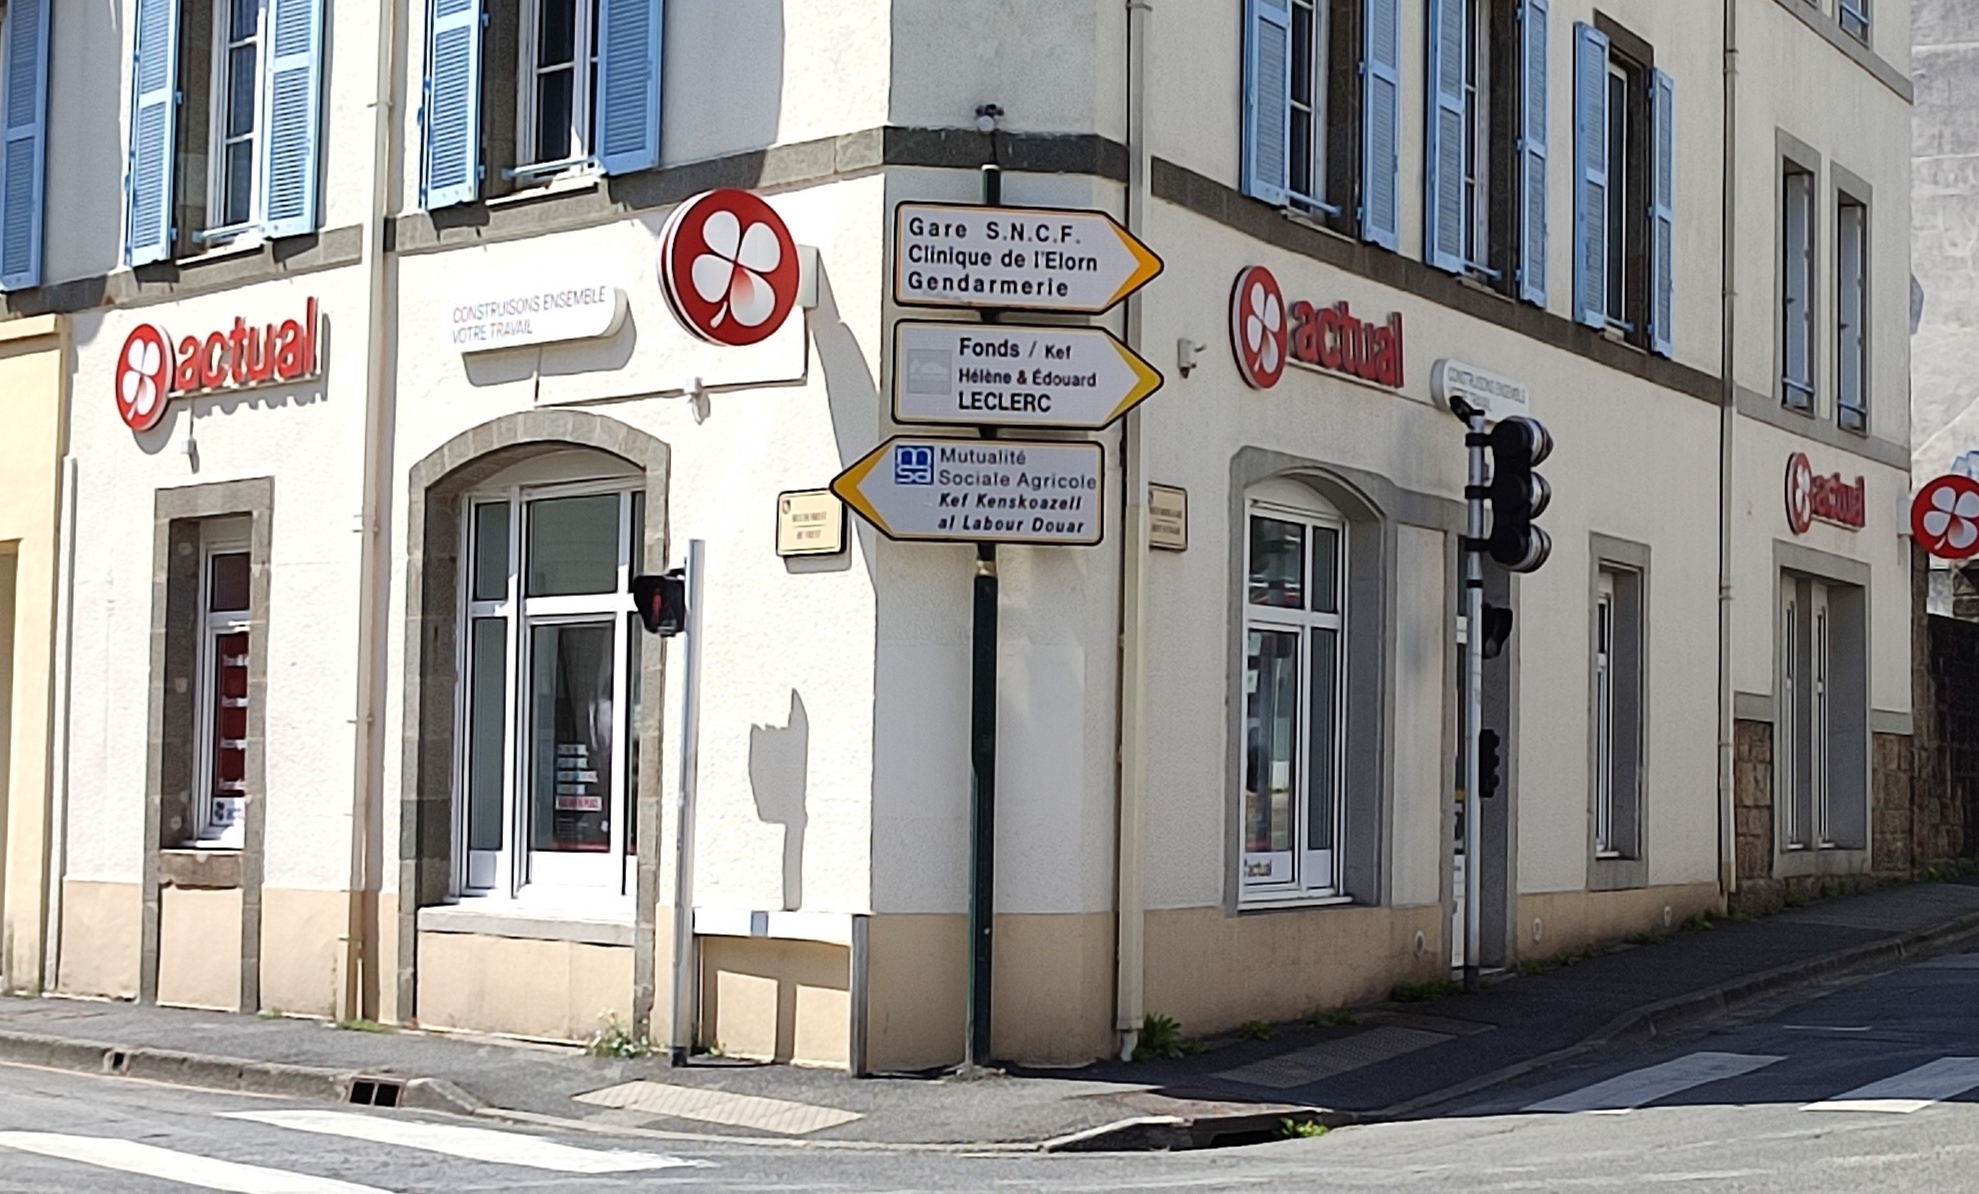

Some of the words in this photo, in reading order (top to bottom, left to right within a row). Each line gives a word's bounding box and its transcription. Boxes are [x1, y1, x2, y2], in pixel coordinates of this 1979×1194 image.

[909, 217, 967, 239] Gare
[986, 221, 1081, 245] S.N.C.F.
[908, 244, 992, 270] Clinique
[1001, 249, 1026, 268] de
[1034, 250, 1098, 272] l'Elorn
[908, 270, 1068, 297] Gendarmerie
[543, 285, 606, 311] ENSEMBLE
[452, 324, 487, 344] VOTRE
[490, 318, 533, 338] TRAVAIL
[175, 296, 317, 392] actual
[959, 337, 1020, 358] Fonds
[1028, 340, 1038, 358] /
[1044, 344, 1072, 360] Kef
[1289, 300, 1404, 389] actual
[959, 367, 1012, 384] Hélène
[1017, 370, 1027, 385] &
[1032, 368, 1097, 387] Édouard
[959, 391, 1052, 413] LECLERC
[940, 447, 1026, 466] Mutualité
[938, 469, 1010, 487] Sociale
[1017, 471, 1097, 491] Agricole
[939, 492, 969, 508] Kef
[938, 514, 955, 531] al
[962, 514, 1024, 532] Labour
[1031, 516, 1085, 533] Douar
